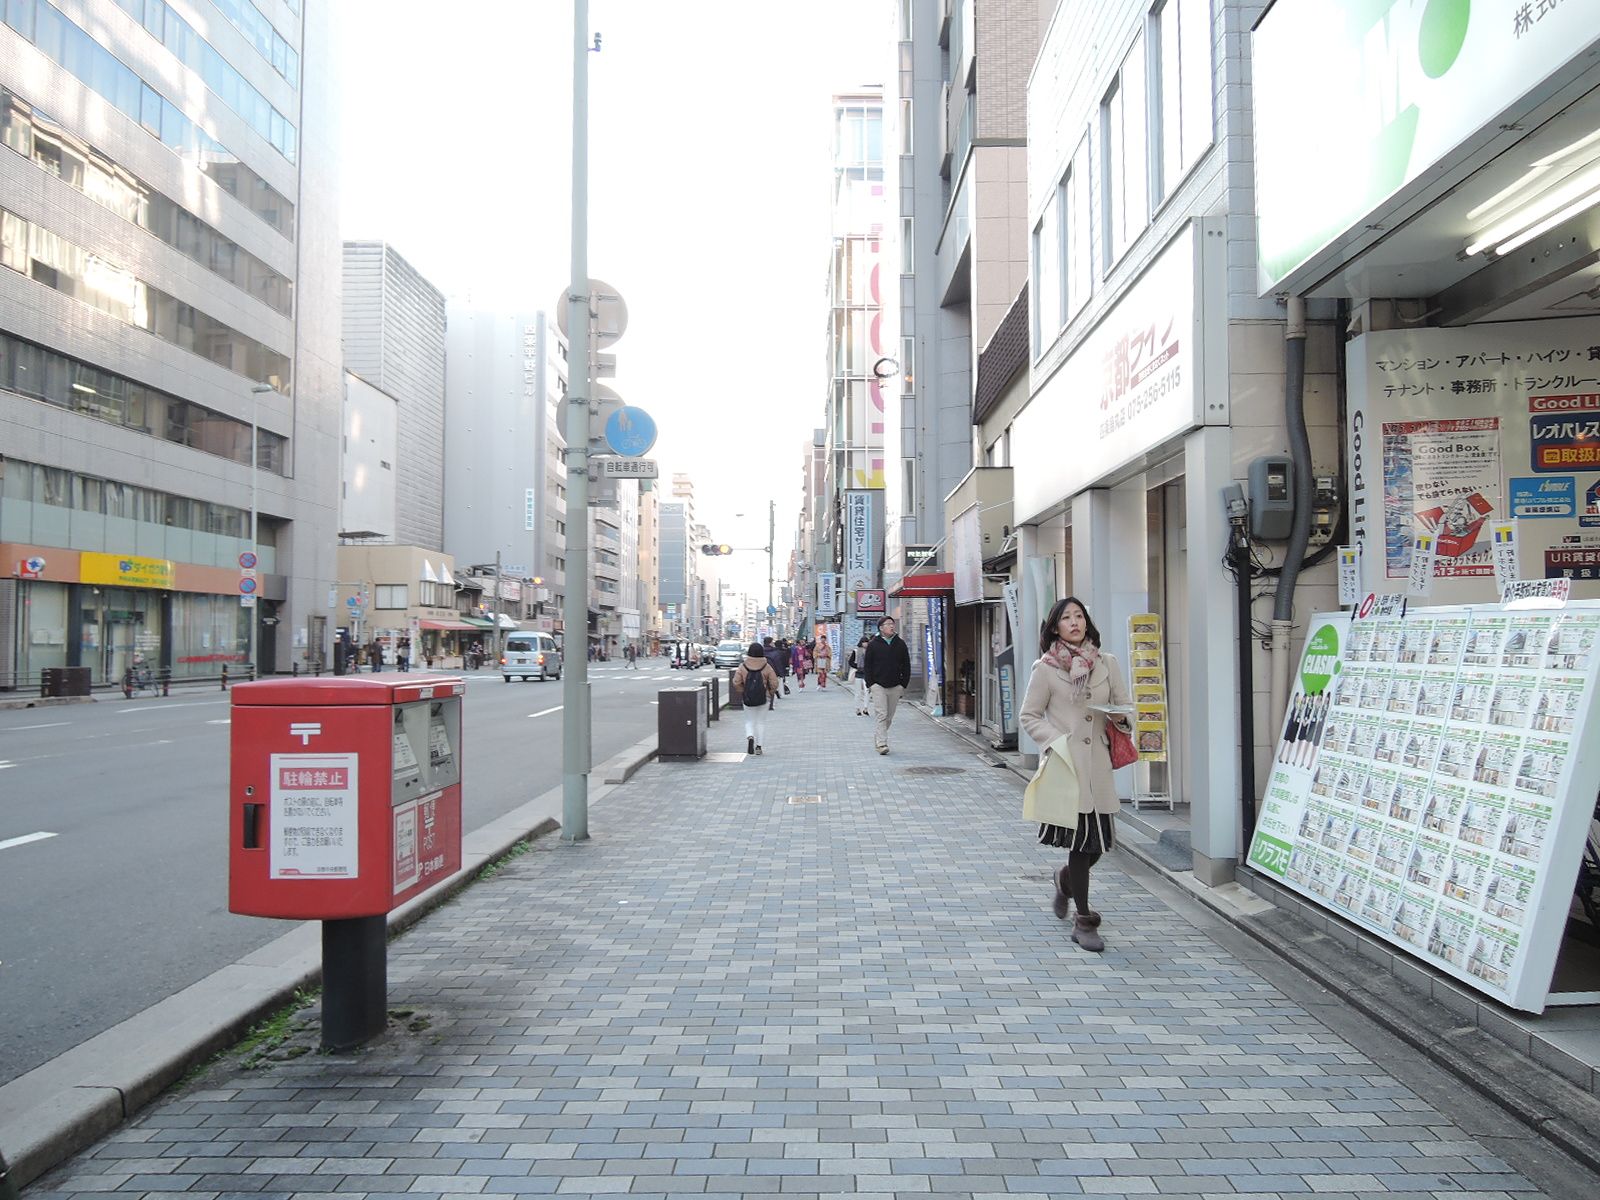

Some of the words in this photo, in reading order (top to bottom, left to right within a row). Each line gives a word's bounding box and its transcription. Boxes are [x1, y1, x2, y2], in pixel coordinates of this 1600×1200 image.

[1513, 0, 1565, 39] 株式
[1383, 374, 1600, 398] テナント・事務所・トランクルー
[1533, 395, 1581, 409] Good
[1353, 410, 1365, 491] Good
[1418, 444, 1453, 454] Good
[1456, 443, 1480, 452] Box
[1561, 447, 1600, 463] 取扱
[854, 495, 865, 570] 賃貸住宅サービス
[283, 770, 344, 787] 駐輪禁止
[1258, 840, 1290, 873] クラスモ
